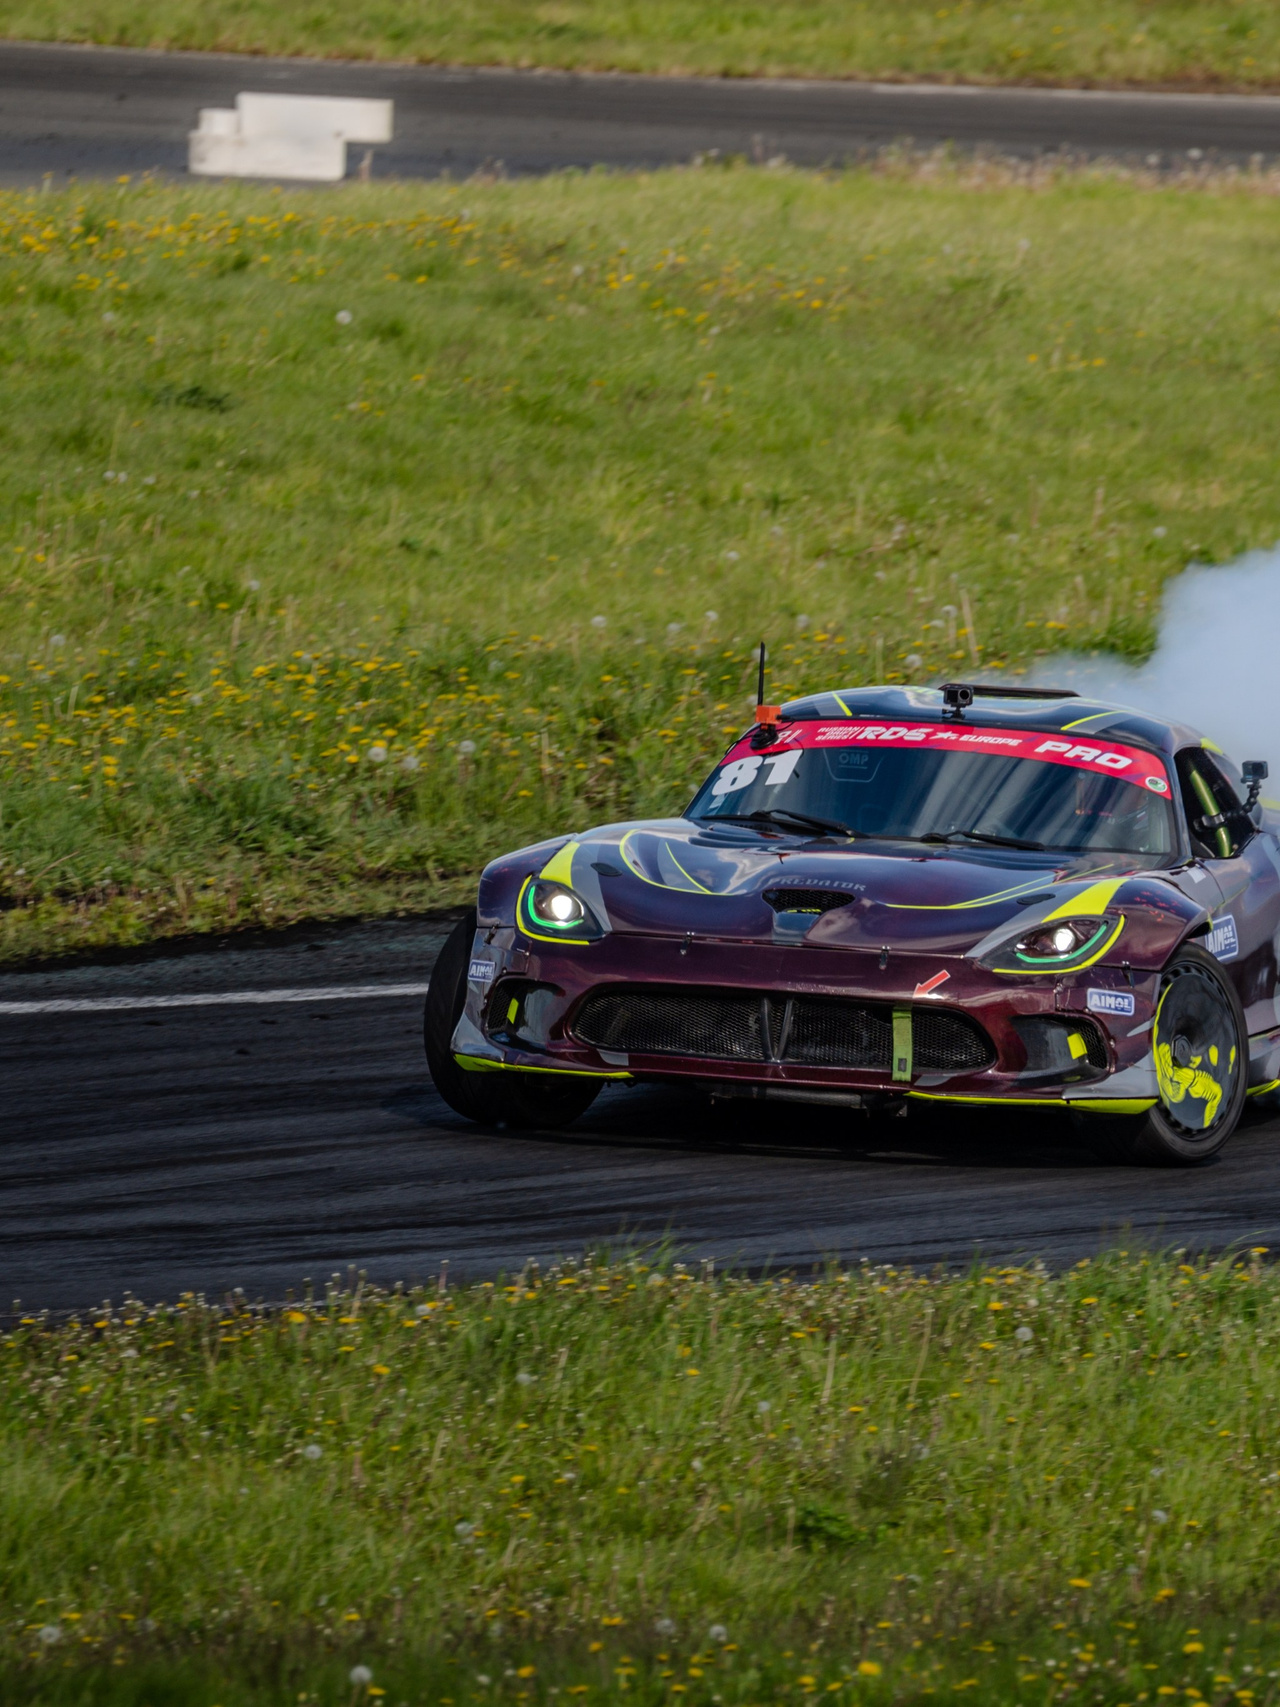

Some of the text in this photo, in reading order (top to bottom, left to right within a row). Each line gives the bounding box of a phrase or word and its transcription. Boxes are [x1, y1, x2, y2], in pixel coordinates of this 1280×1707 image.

[856, 726, 1133, 770] RDS EUROPE PRO
[838, 752, 869, 765] OMP
[711, 749, 803, 796] 81
[768, 878, 867, 891] PREDATOR
[1090, 994, 1132, 1009] AIMOL
